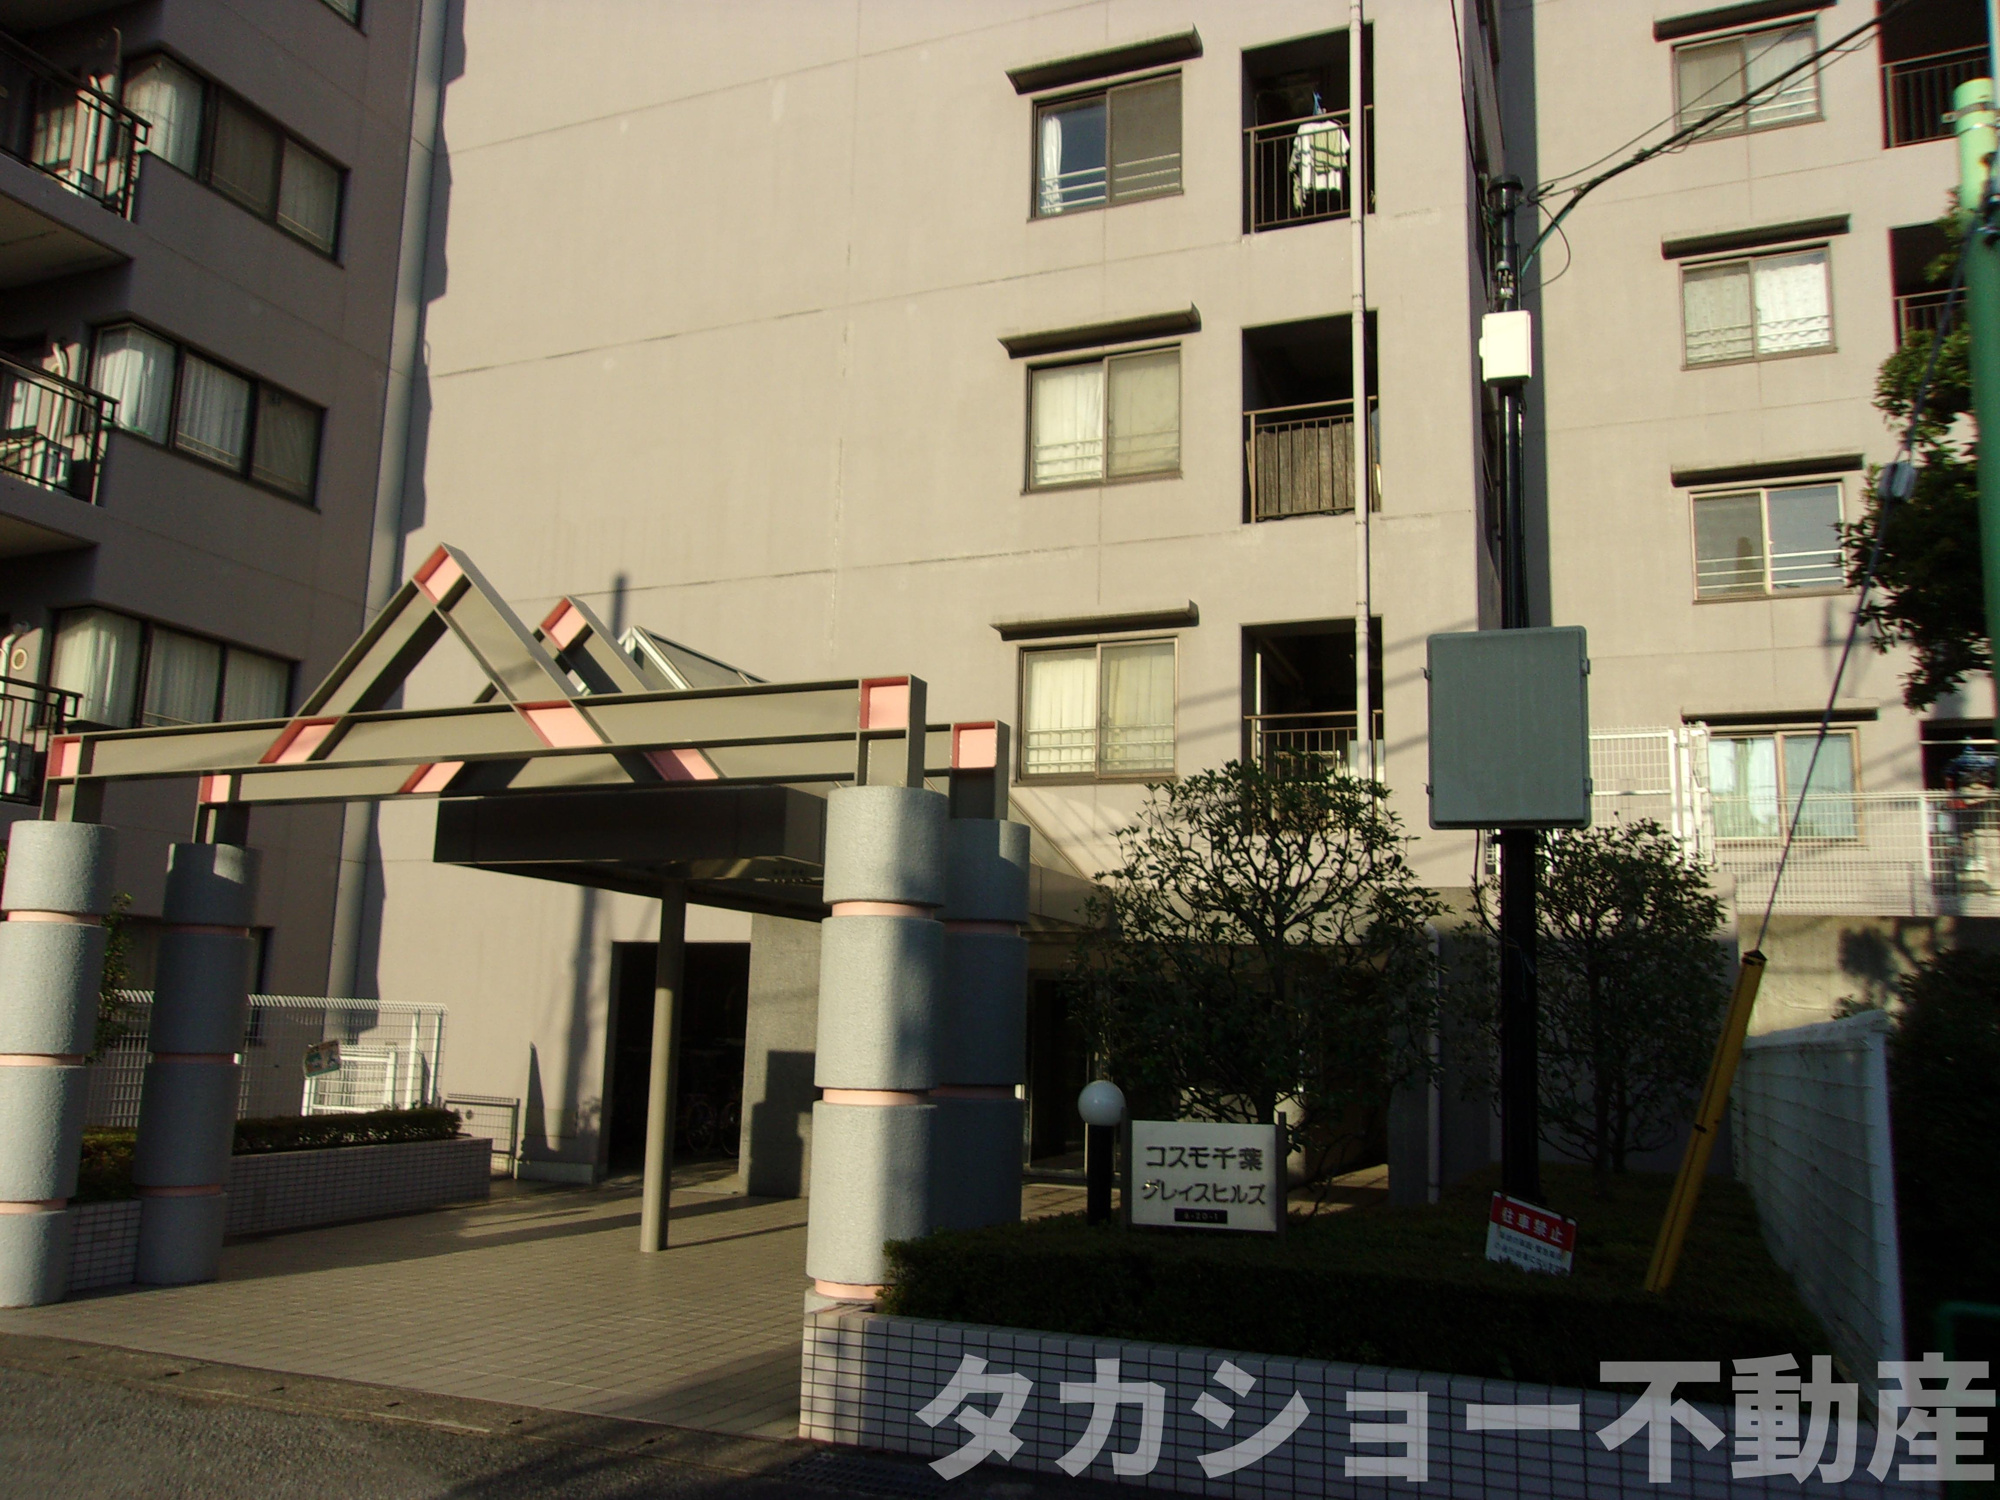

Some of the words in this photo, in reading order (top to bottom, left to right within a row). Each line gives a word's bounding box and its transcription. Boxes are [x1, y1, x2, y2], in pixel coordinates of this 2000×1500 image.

[1146, 1146, 1262, 1170] コスモ千葉
[1502, 1207, 1563, 1243] 駐車禁止
